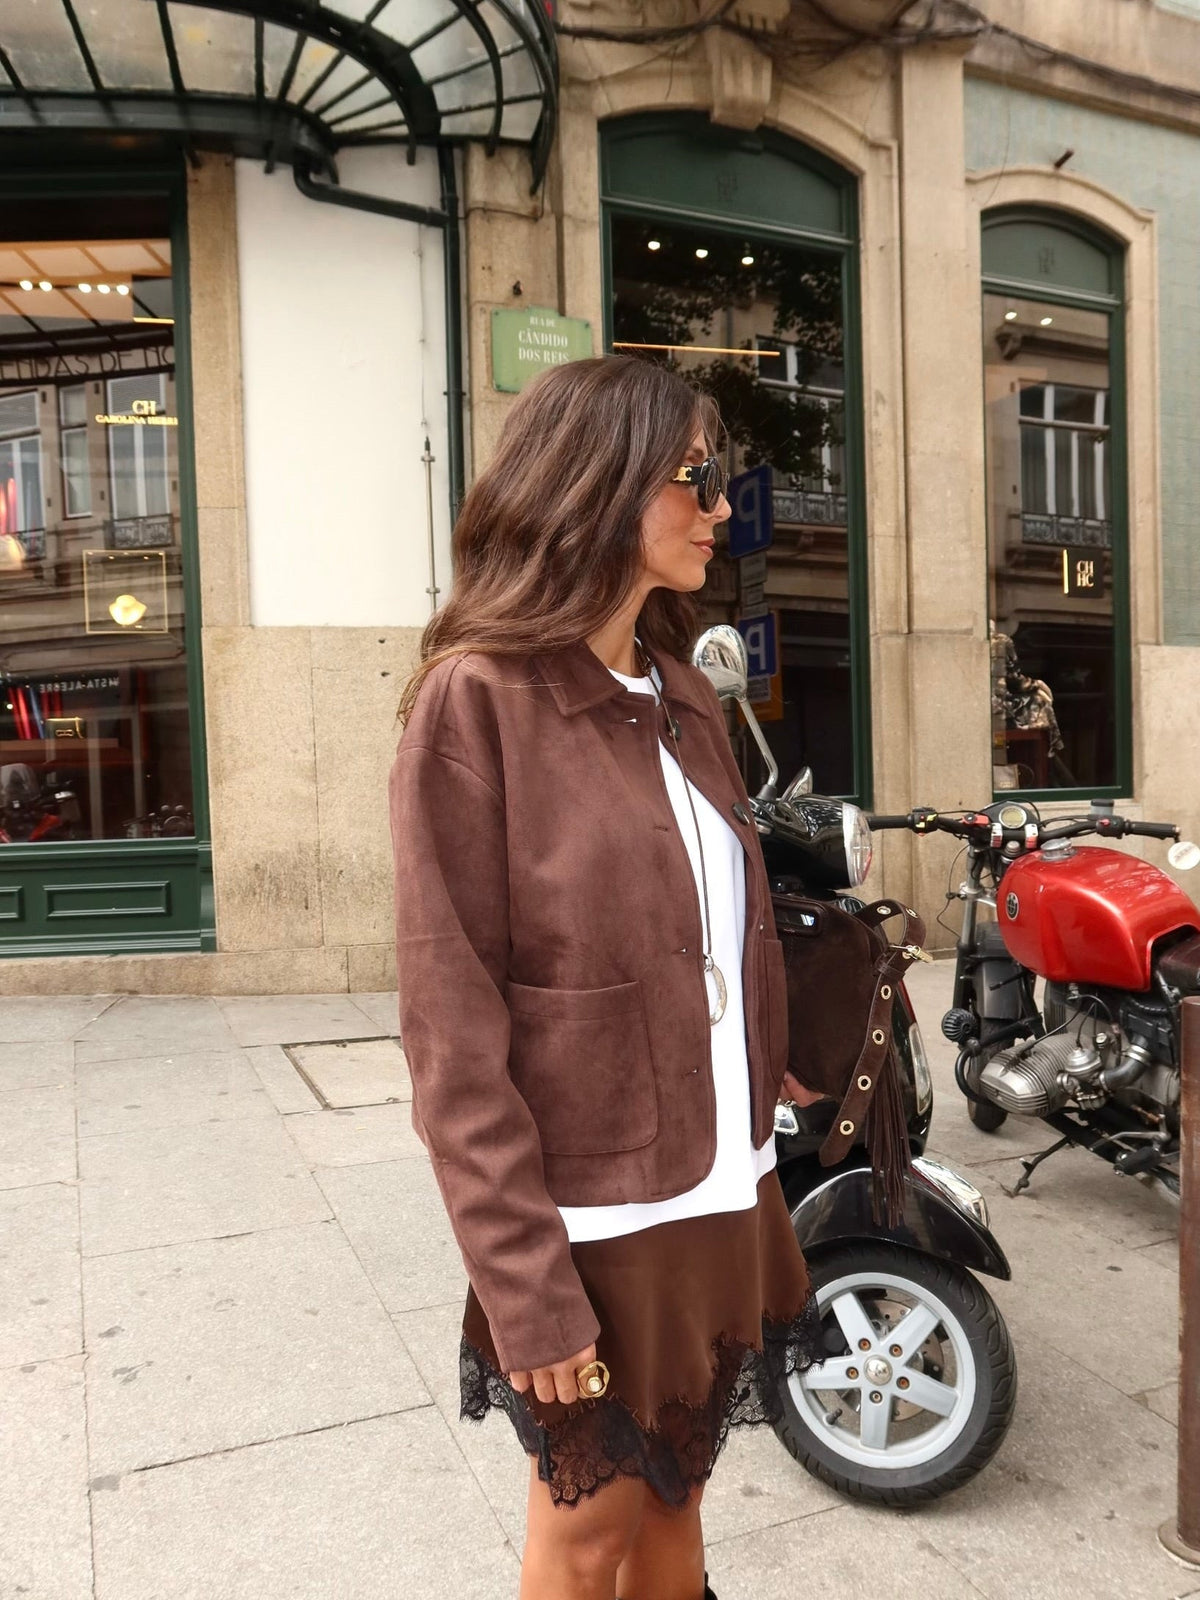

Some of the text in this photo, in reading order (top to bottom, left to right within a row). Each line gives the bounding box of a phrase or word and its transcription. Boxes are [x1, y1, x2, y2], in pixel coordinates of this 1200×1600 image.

[518, 327, 568, 347] CÂNDIDO
[518, 348, 570, 365] DOS REIS
[132, 400, 157, 416] CH
